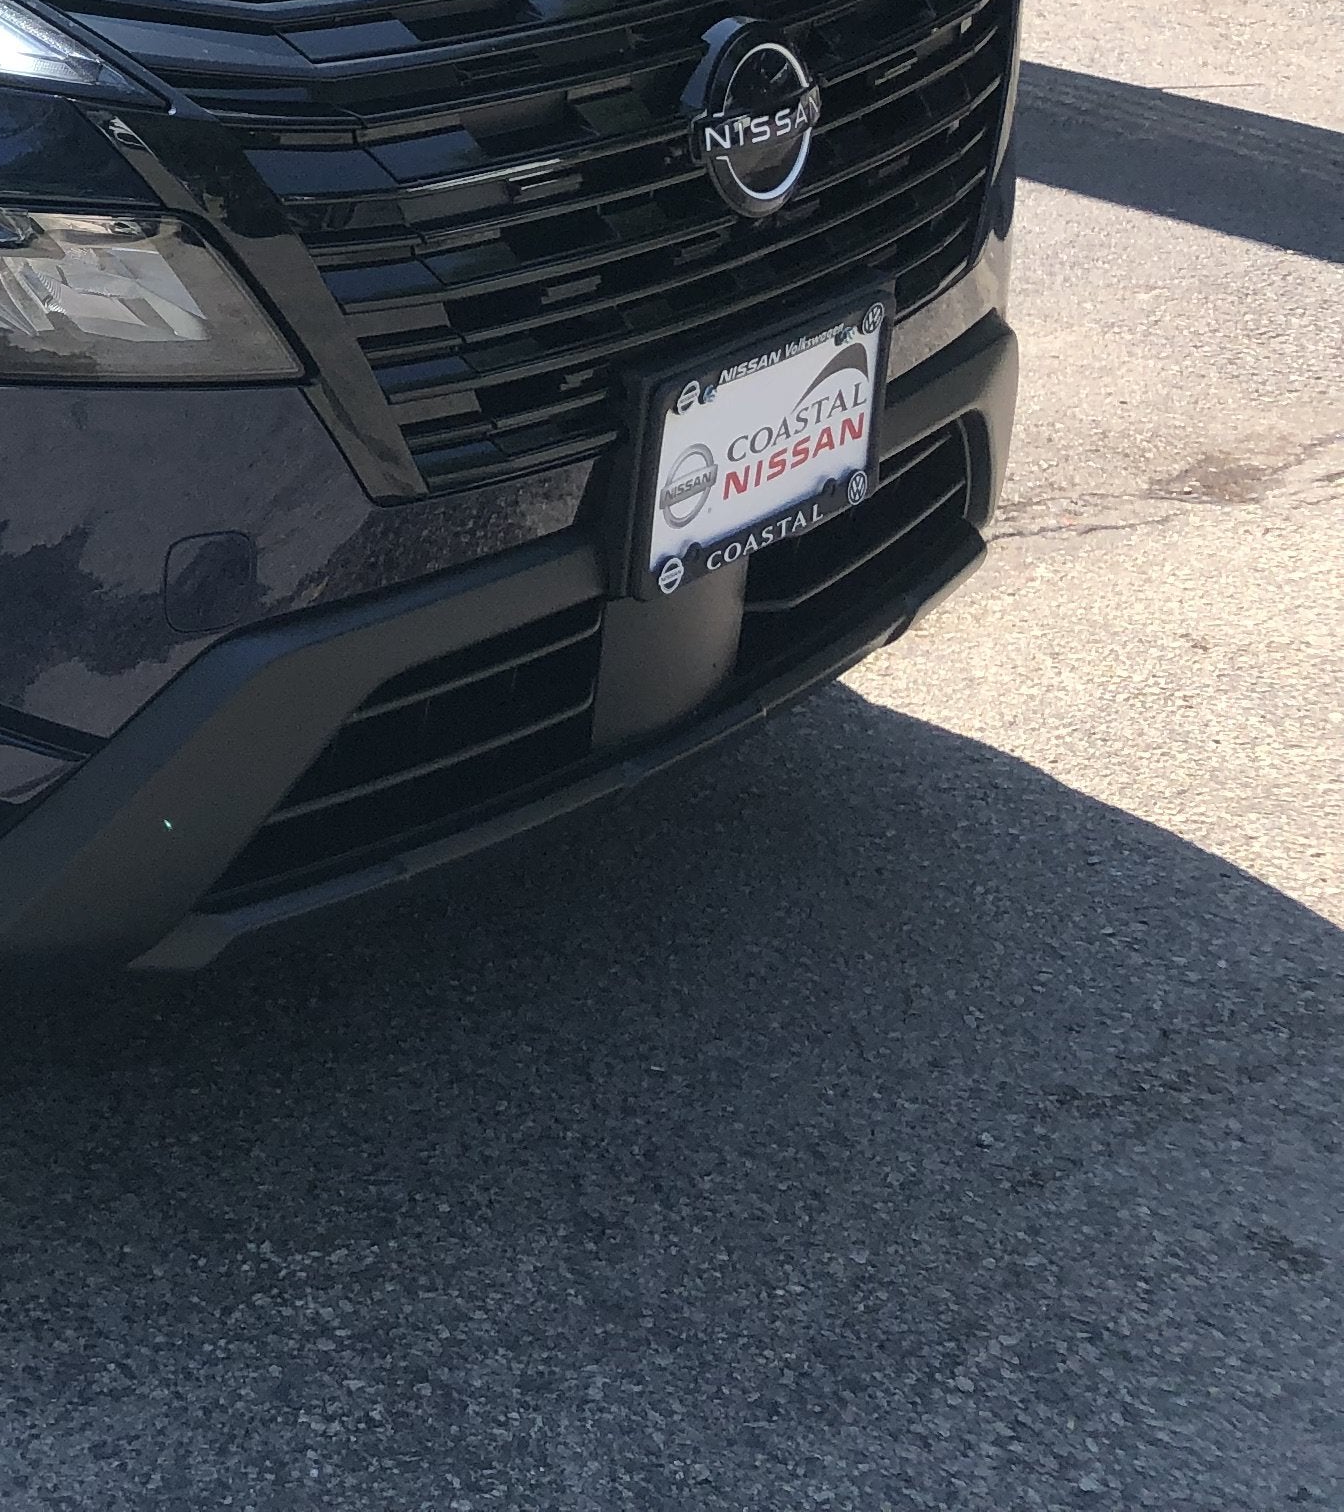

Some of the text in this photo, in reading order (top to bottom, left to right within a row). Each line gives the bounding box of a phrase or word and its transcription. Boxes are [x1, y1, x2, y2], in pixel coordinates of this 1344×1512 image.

[705, 96, 818, 152] NISSAN
[719, 348, 782, 384] NISSAN
[726, 381, 868, 463] COASTAL
[664, 471, 713, 501] NISSAN
[723, 411, 865, 501] NISSAN
[706, 503, 824, 571] COASTAL
